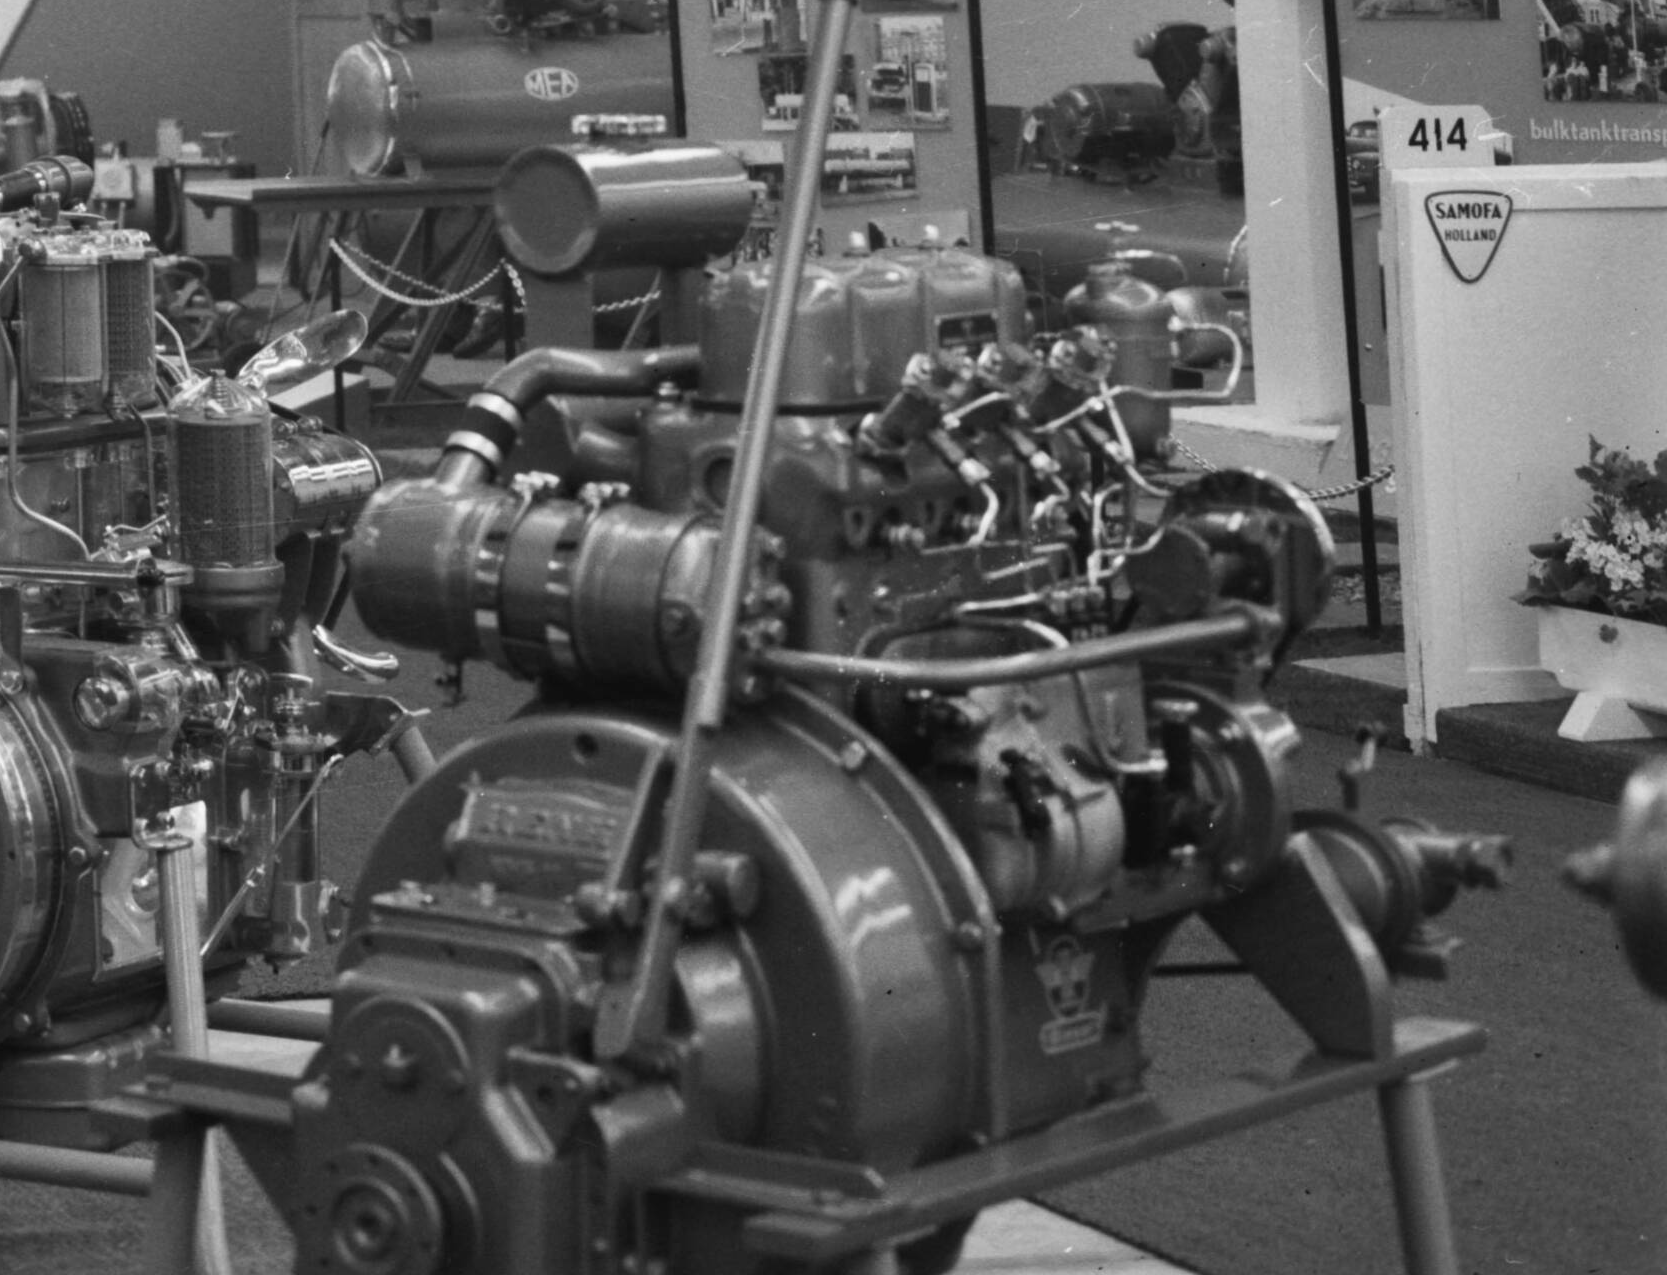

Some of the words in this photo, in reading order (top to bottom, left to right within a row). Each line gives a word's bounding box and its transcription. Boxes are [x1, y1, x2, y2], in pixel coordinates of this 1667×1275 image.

[525, 68, 578, 100] MEA
[1408, 117, 1468, 152] 414
[1435, 202, 1503, 220] SAMOFA
[1444, 229, 1497, 242] HOLLAND
